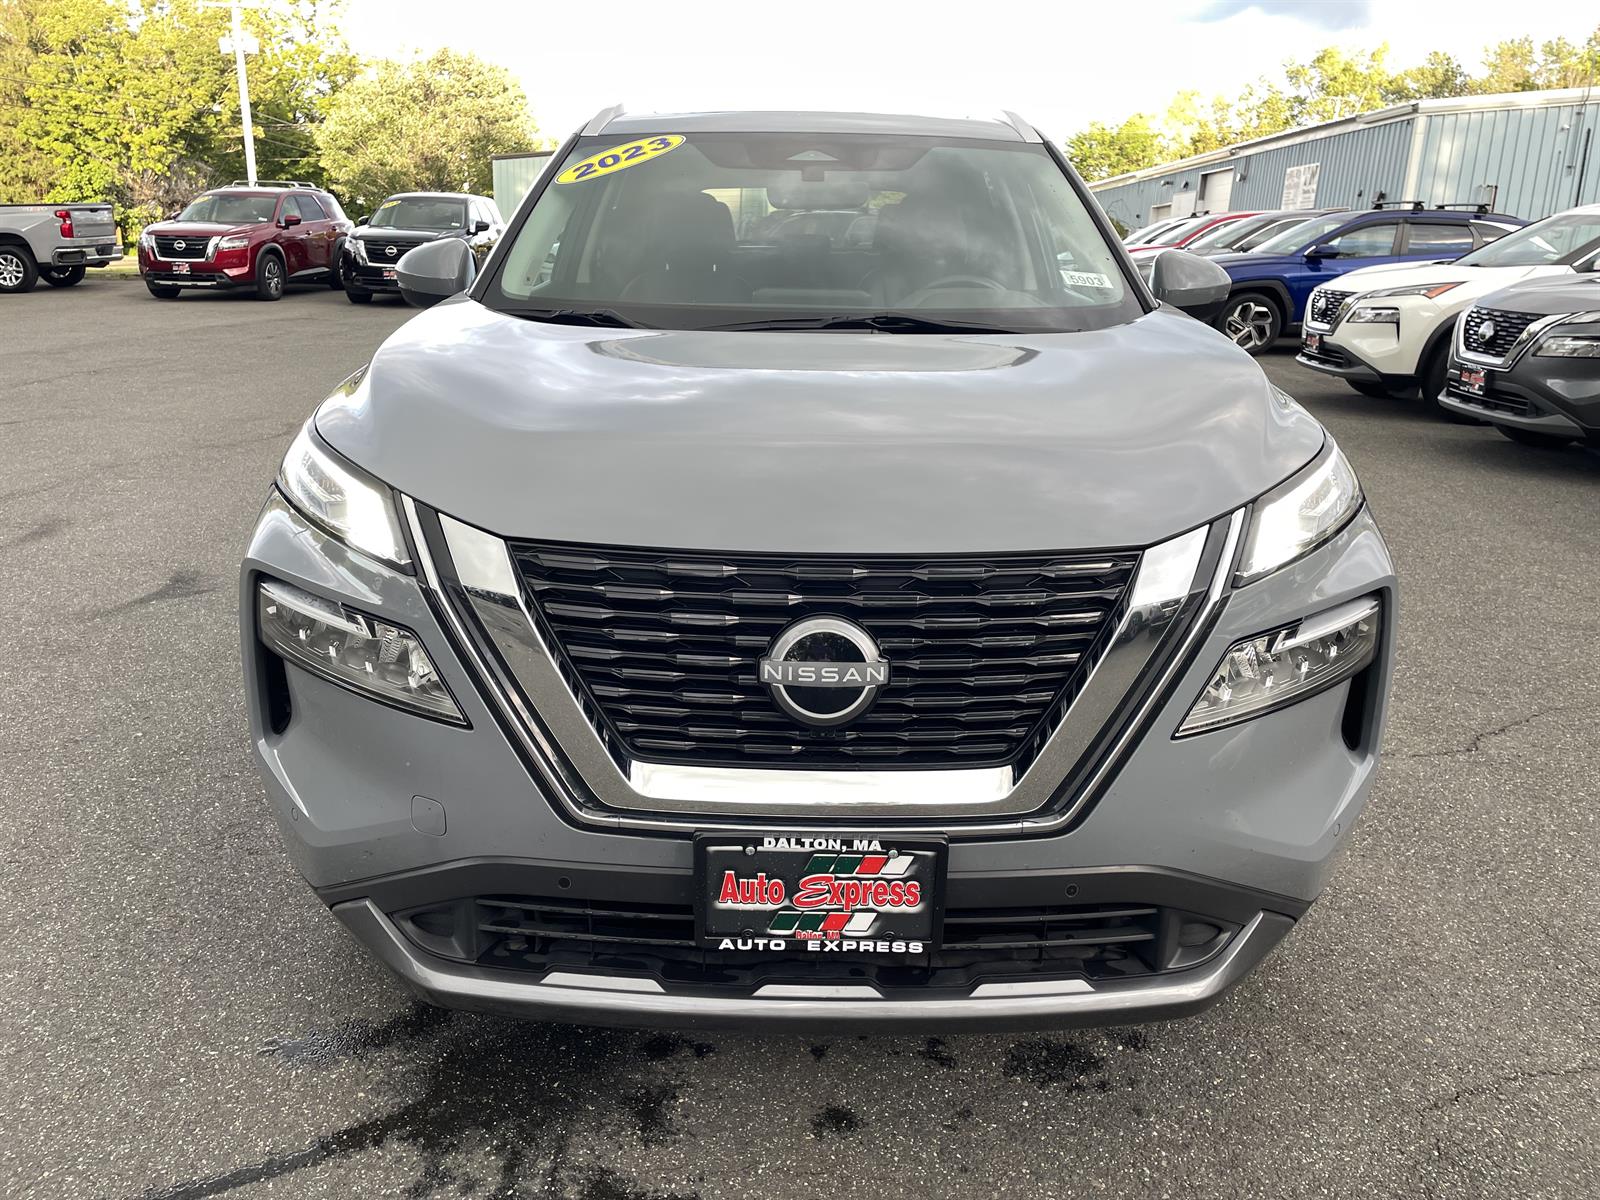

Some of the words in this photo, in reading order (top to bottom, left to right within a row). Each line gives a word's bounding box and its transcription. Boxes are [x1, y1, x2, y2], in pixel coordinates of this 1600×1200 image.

[572, 137, 673, 181] 2023
[1070, 275, 1104, 286] 5903
[764, 664, 885, 682] NISSAN
[763, 837, 847, 852] DALTON,
[853, 839, 882, 851] MA
[719, 871, 786, 906] Auto
[793, 874, 921, 911] Express
[718, 939, 786, 951] AUTO
[807, 940, 924, 953] EXPRESS
